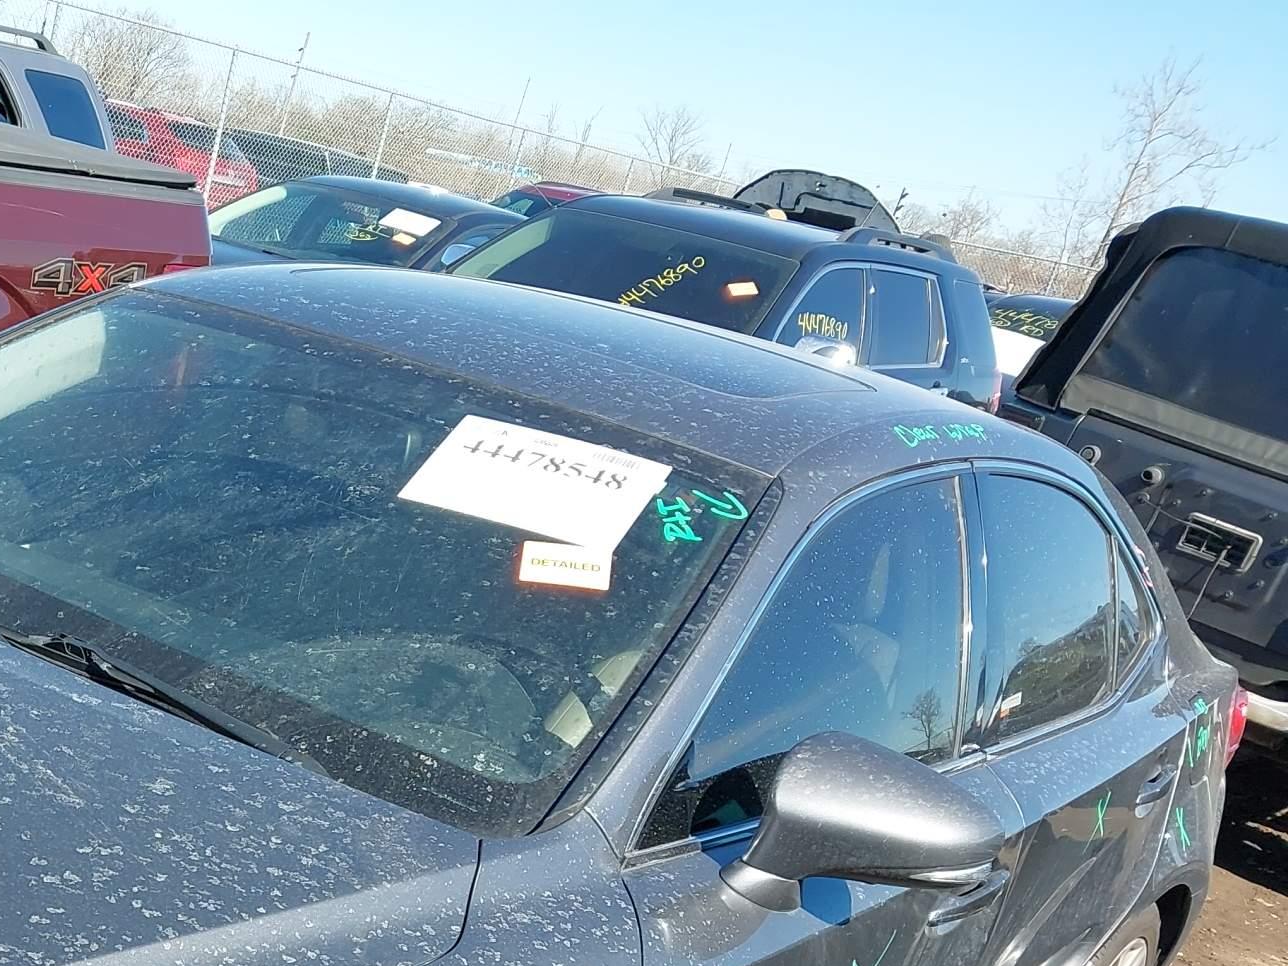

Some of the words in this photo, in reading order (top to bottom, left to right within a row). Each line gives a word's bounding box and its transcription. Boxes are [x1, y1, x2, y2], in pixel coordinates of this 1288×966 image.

[798, 311, 848, 340] 44476890
[463, 439, 628, 490] 44478548
[530, 557, 602, 573] DETAILED
